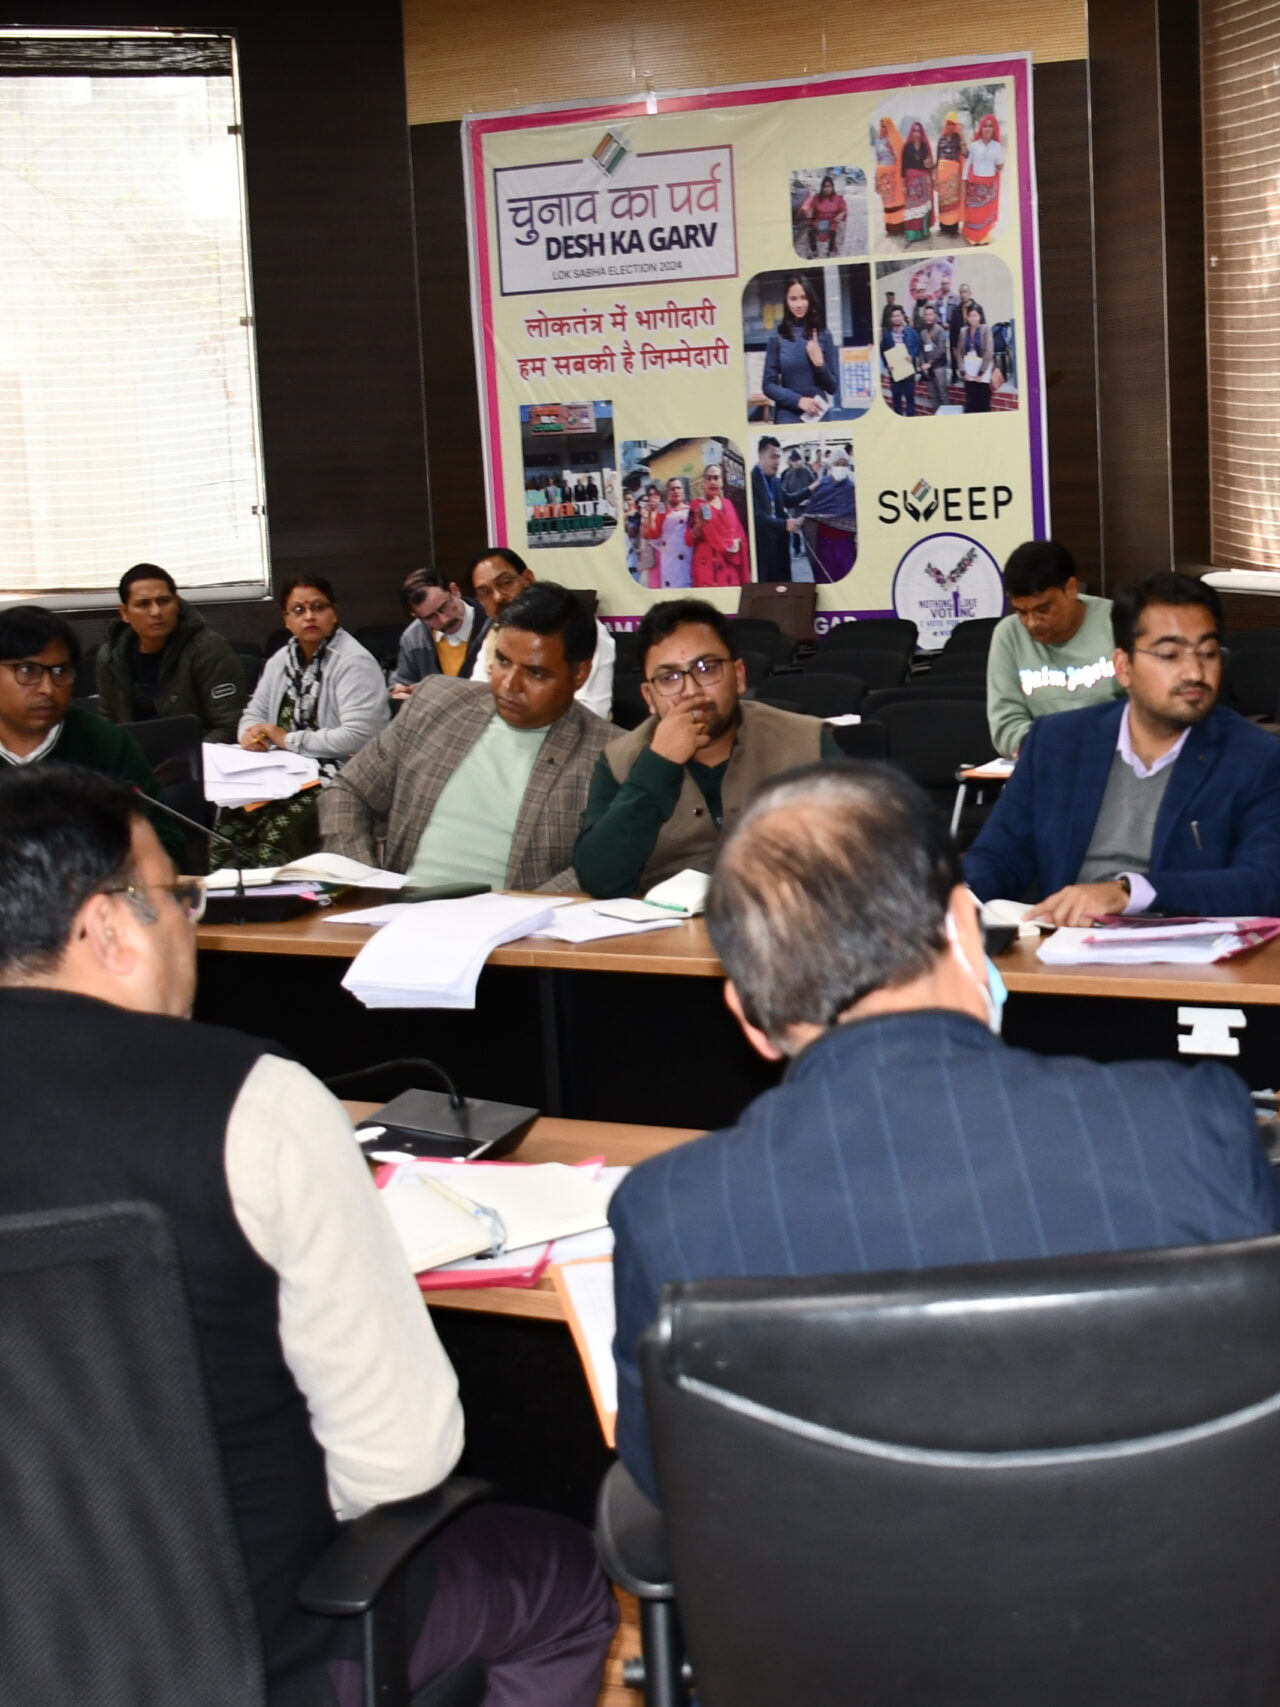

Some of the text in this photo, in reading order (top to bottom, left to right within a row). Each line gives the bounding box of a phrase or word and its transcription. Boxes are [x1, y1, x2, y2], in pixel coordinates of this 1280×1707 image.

[507, 162, 722, 246] चुनाव का पर्व
[545, 222, 718, 261] DESH KA GARV
[552, 260, 683, 281] LOK SABHA ELECTION 2024
[525, 298, 716, 338] लोकतंत्र में भागीदारी
[517, 337, 730, 381] हम सबकी है जिम्मेदारी
[878, 485, 1013, 525] SWEEP
